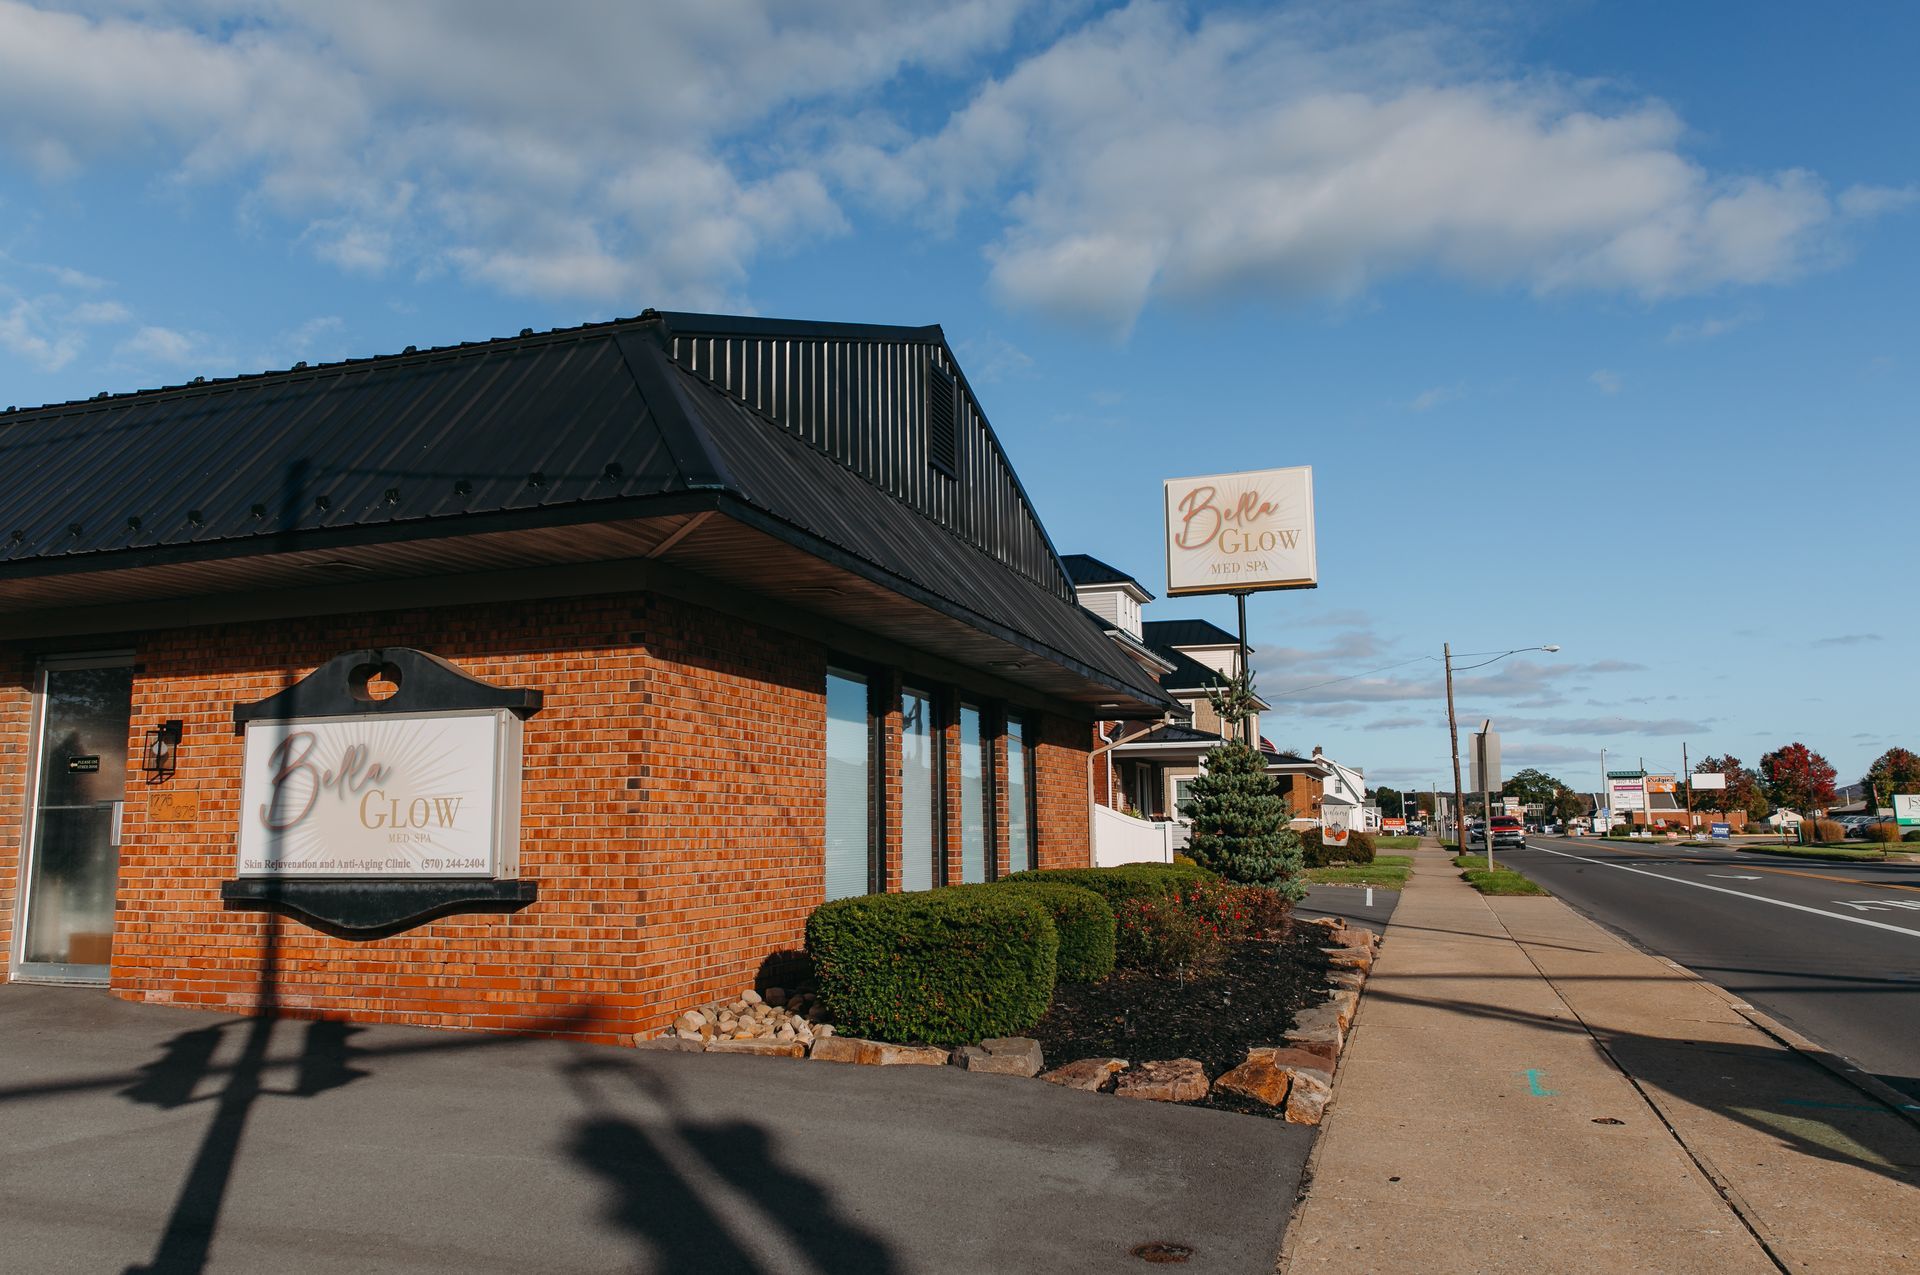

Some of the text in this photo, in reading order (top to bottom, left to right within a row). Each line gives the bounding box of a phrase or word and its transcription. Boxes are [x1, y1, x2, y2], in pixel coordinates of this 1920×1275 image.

[1174, 486, 1279, 550] Bella
[1211, 560, 1269, 575] MED SPA
[259, 730, 394, 831] Bella
[150, 793, 173, 807] 1776
[388, 832, 432, 843] MED SPA
[244, 858, 485, 871] Skin Rejuvenation and Anti-Aging Clinic (570) 244-2404
